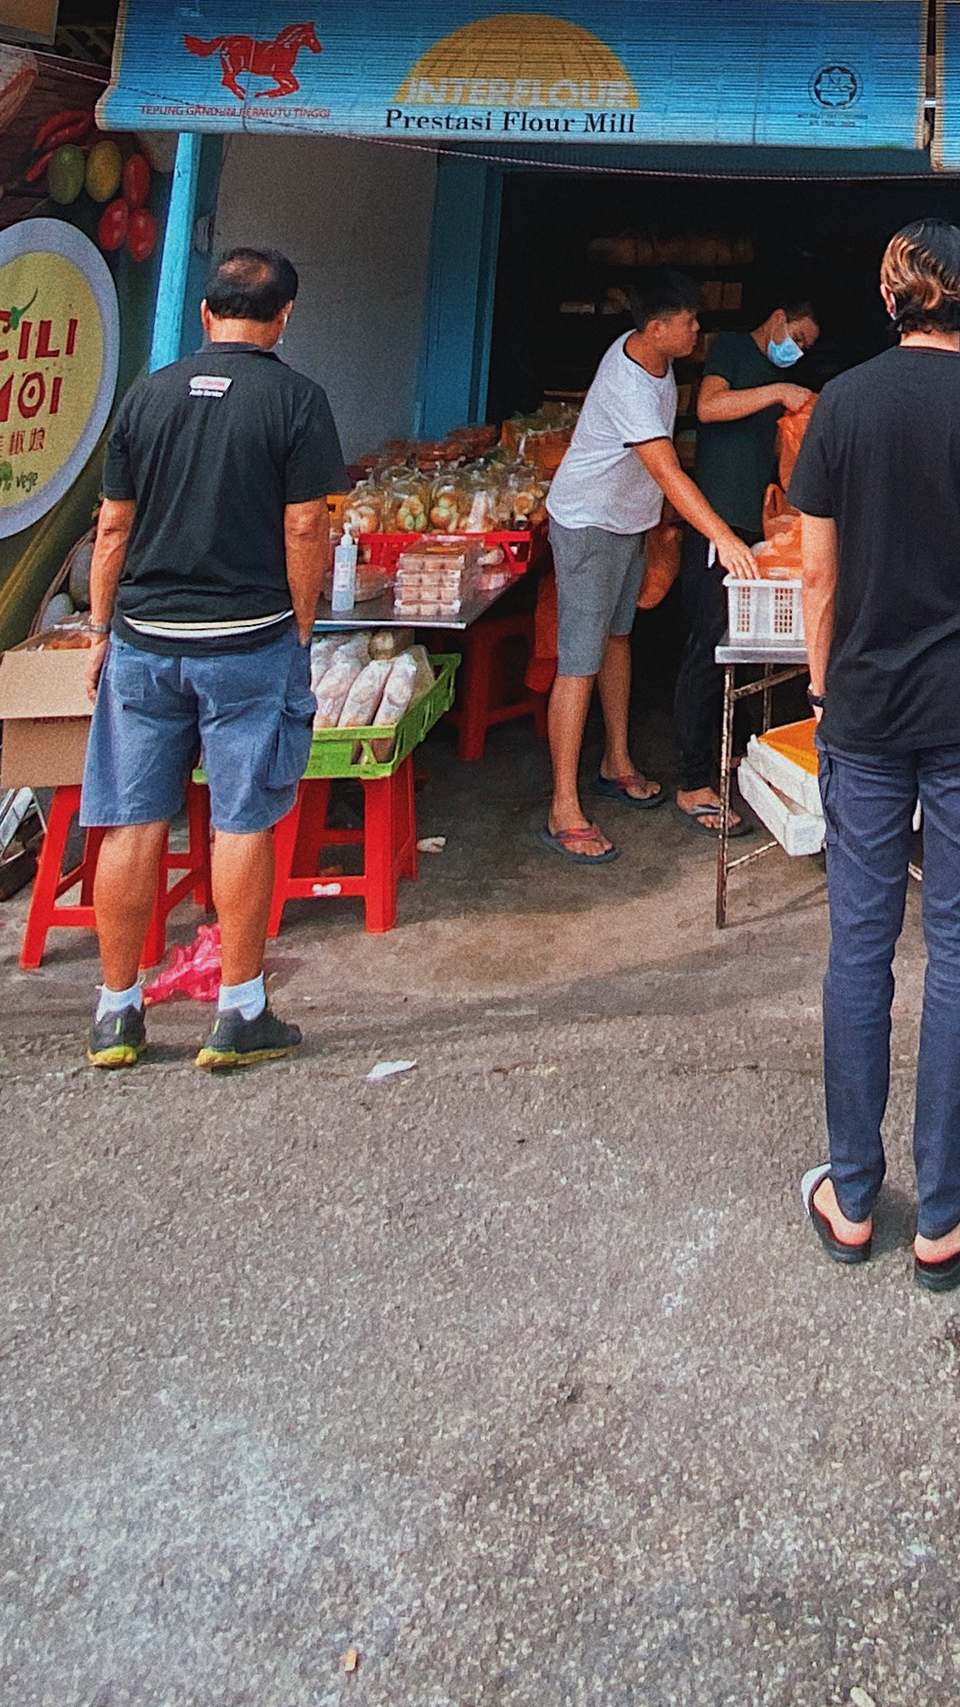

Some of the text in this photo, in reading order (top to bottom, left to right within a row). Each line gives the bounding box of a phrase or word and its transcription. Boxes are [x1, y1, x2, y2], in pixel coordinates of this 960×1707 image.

[402, 77, 631, 109] INTERFLOUR
[141, 104, 184, 116] TEPUNG
[293, 107, 331, 119] TINGGI
[384, 108, 636, 134] Prestasi Flour Mill
